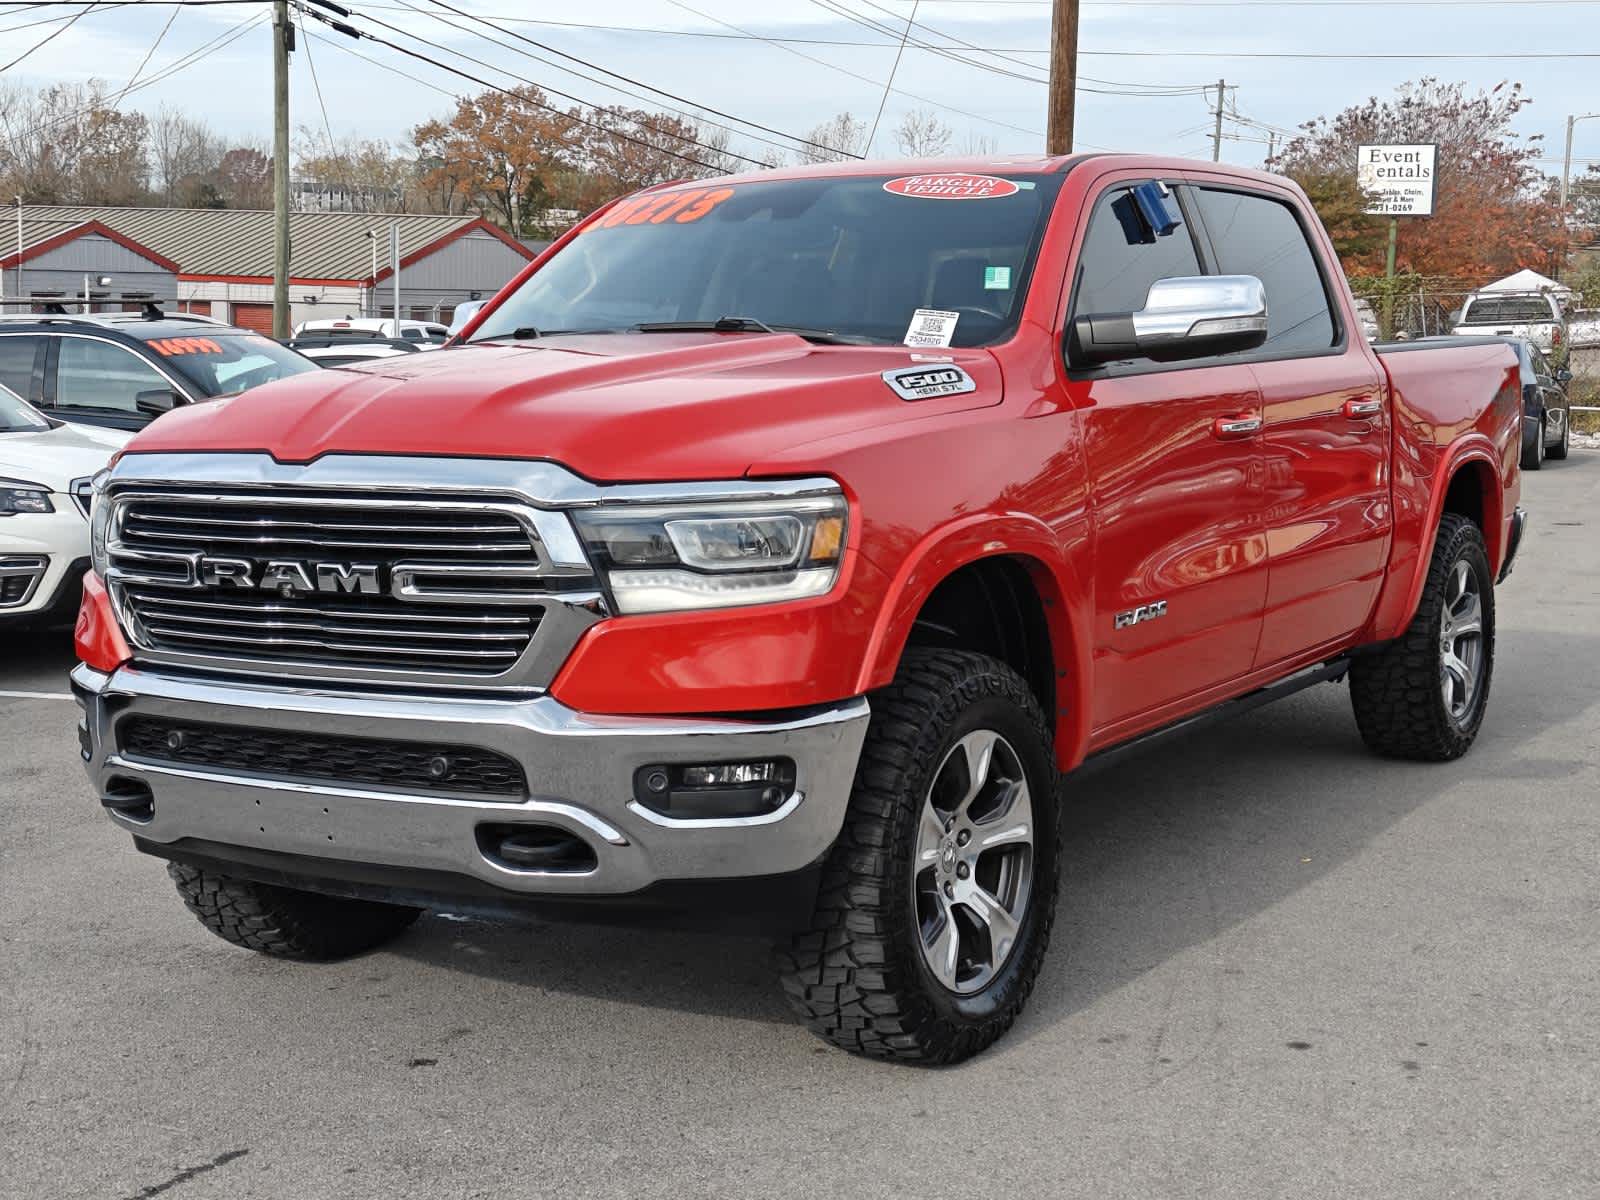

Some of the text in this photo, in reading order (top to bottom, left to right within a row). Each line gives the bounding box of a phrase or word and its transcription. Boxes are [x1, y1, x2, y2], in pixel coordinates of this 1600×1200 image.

[1369, 149, 1421, 163] Event
[905, 177, 998, 187] BARGAIN
[903, 185, 993, 196] VEHICLE
[896, 370, 961, 388] 1500
[915, 385, 941, 397] HEMI
[202, 556, 380, 594] RAM
[1114, 600, 1168, 630] RAM
